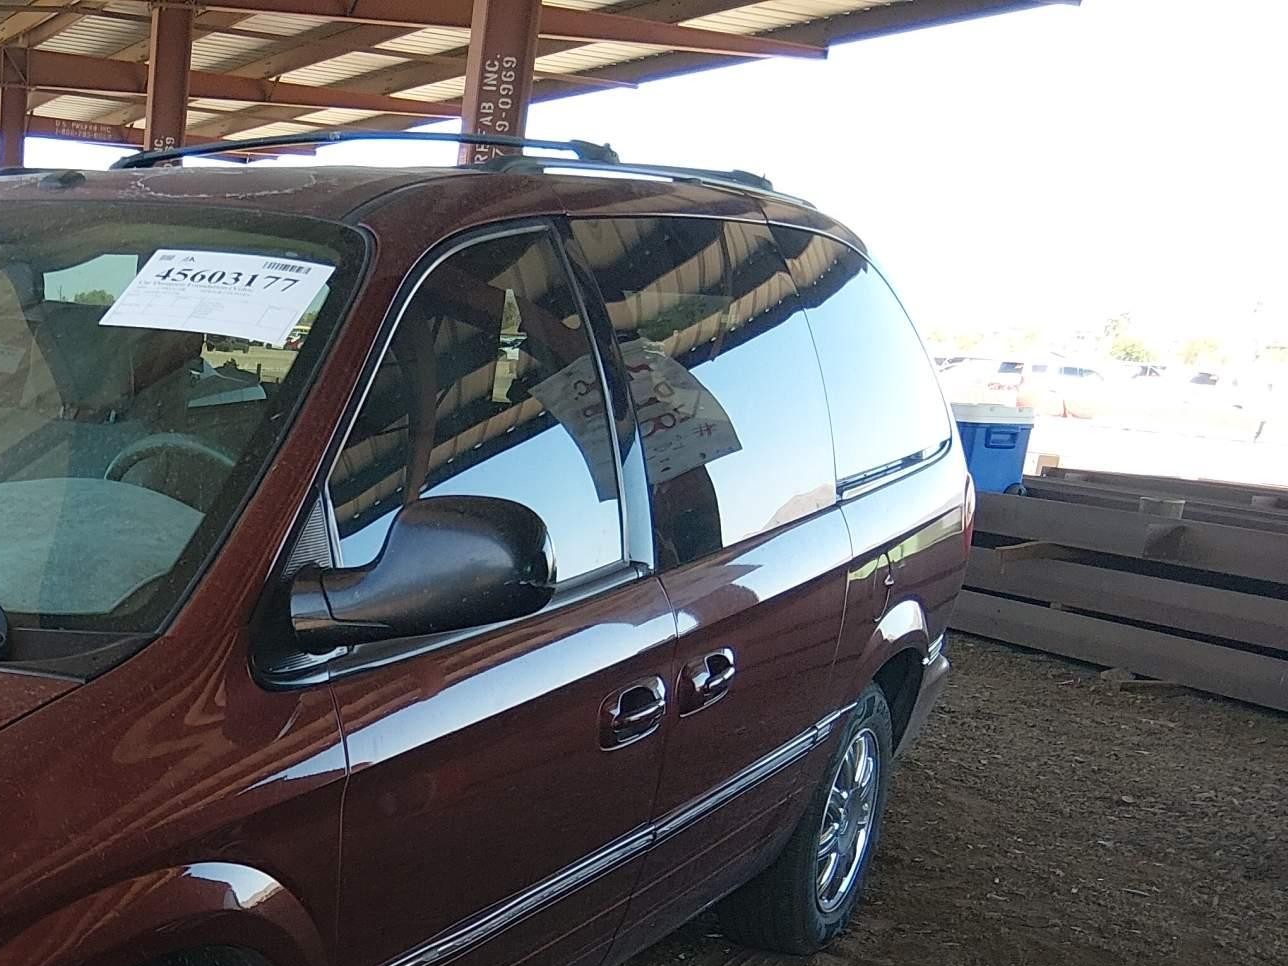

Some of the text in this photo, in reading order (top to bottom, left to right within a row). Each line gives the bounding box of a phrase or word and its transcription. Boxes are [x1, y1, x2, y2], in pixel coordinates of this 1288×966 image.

[484, 54, 501, 91] INC.
[492, 57, 517, 158] 79-0969
[156, 267, 300, 292] 45603177
